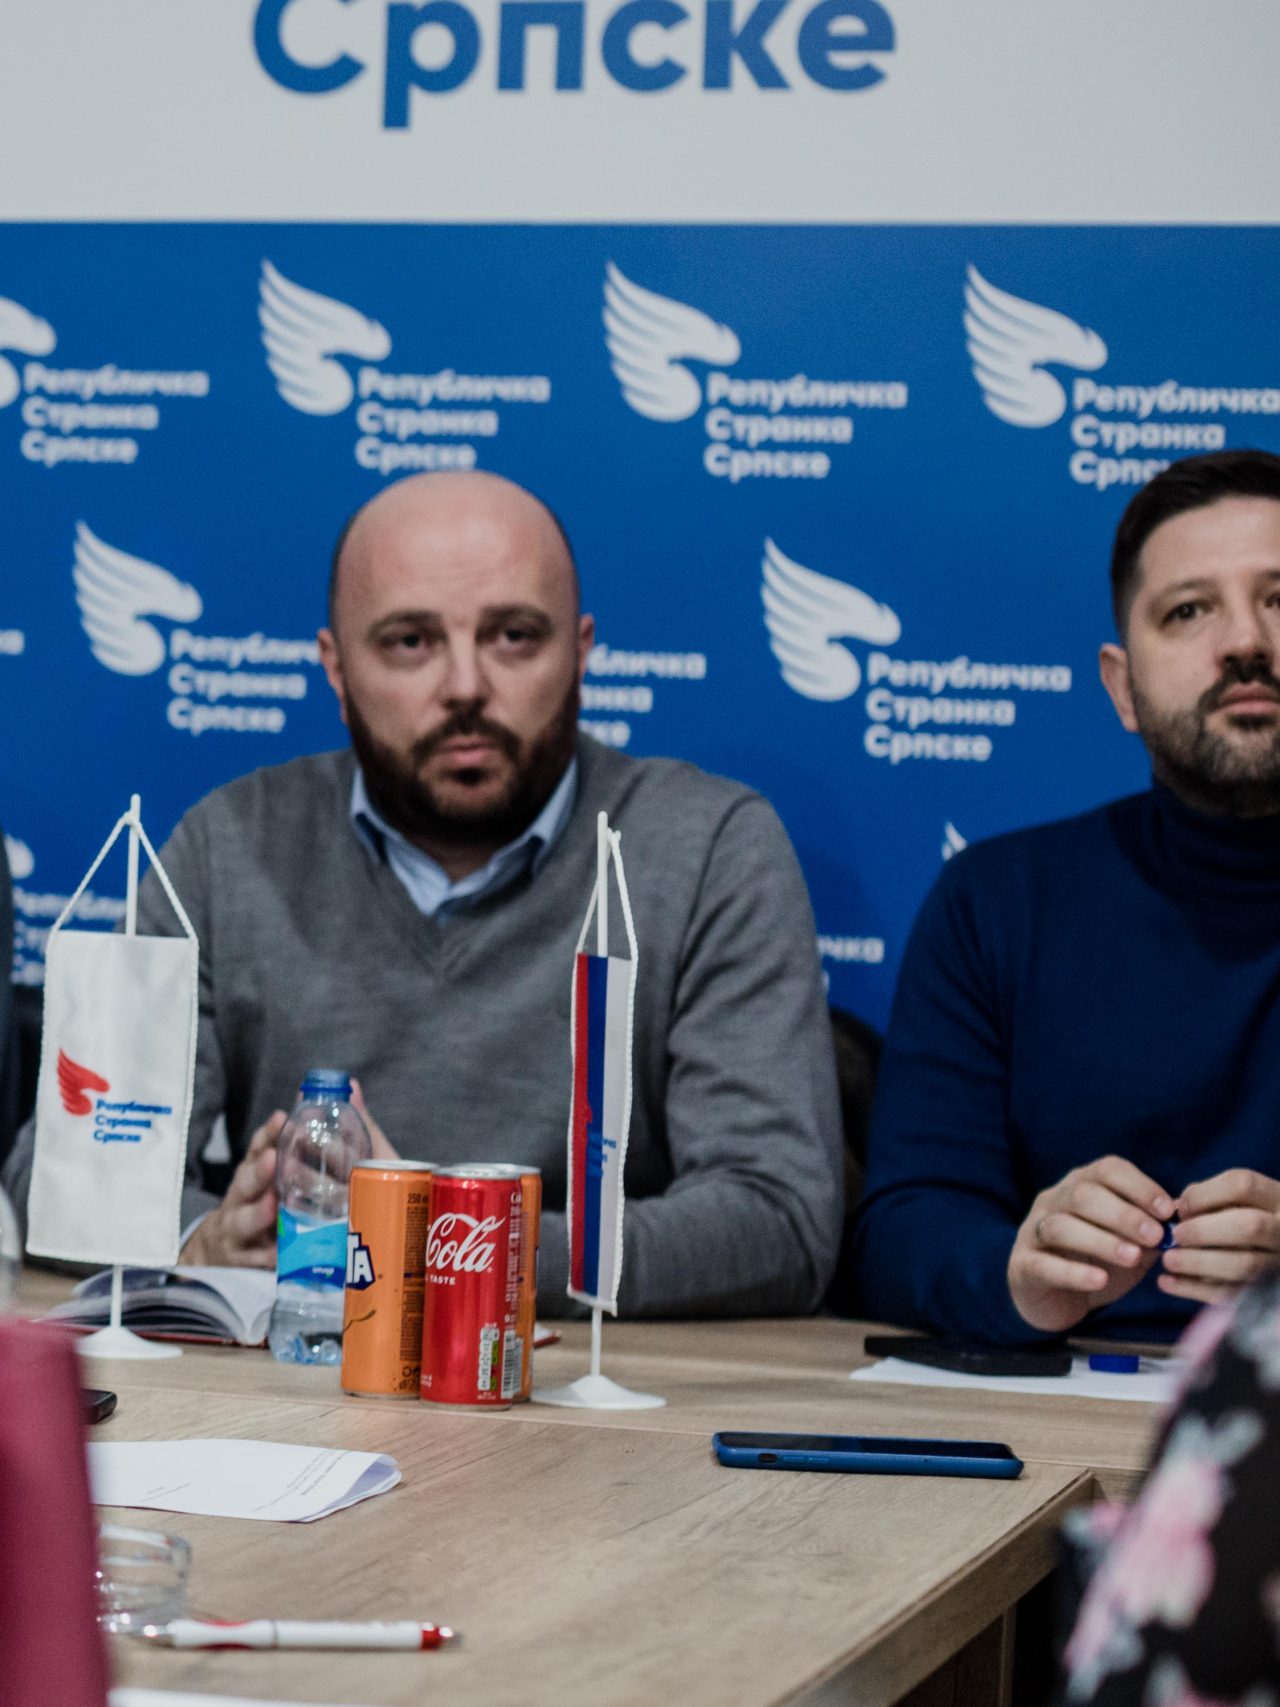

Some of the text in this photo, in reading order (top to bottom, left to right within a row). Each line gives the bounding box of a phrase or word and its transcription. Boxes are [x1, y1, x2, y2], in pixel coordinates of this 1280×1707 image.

[253, 0, 897, 130] Српске
[24, 362, 210, 401] Републичка
[358, 366, 552, 406] Републичка
[707, 372, 908, 413] Републичка
[1073, 378, 1280, 418] Републичка
[22, 396, 158, 434] Странка
[356, 401, 498, 441] Странка
[705, 407, 853, 447] Странка
[1071, 413, 1226, 454] Странка
[21, 429, 138, 467] Српске
[355, 435, 476, 475] Српске
[703, 443, 830, 483] Српске
[1070, 450, 1171, 491] Српс
[170, 629, 320, 668] Републич
[588, 643, 706, 679] бличка
[169, 663, 307, 702] Странка
[868, 652, 1072, 694] Републичка
[167, 697, 286, 736] Српске
[865, 688, 1016, 729] Странка
[864, 724, 993, 765] Српске
[426, 1212, 506, 1273] Cola
